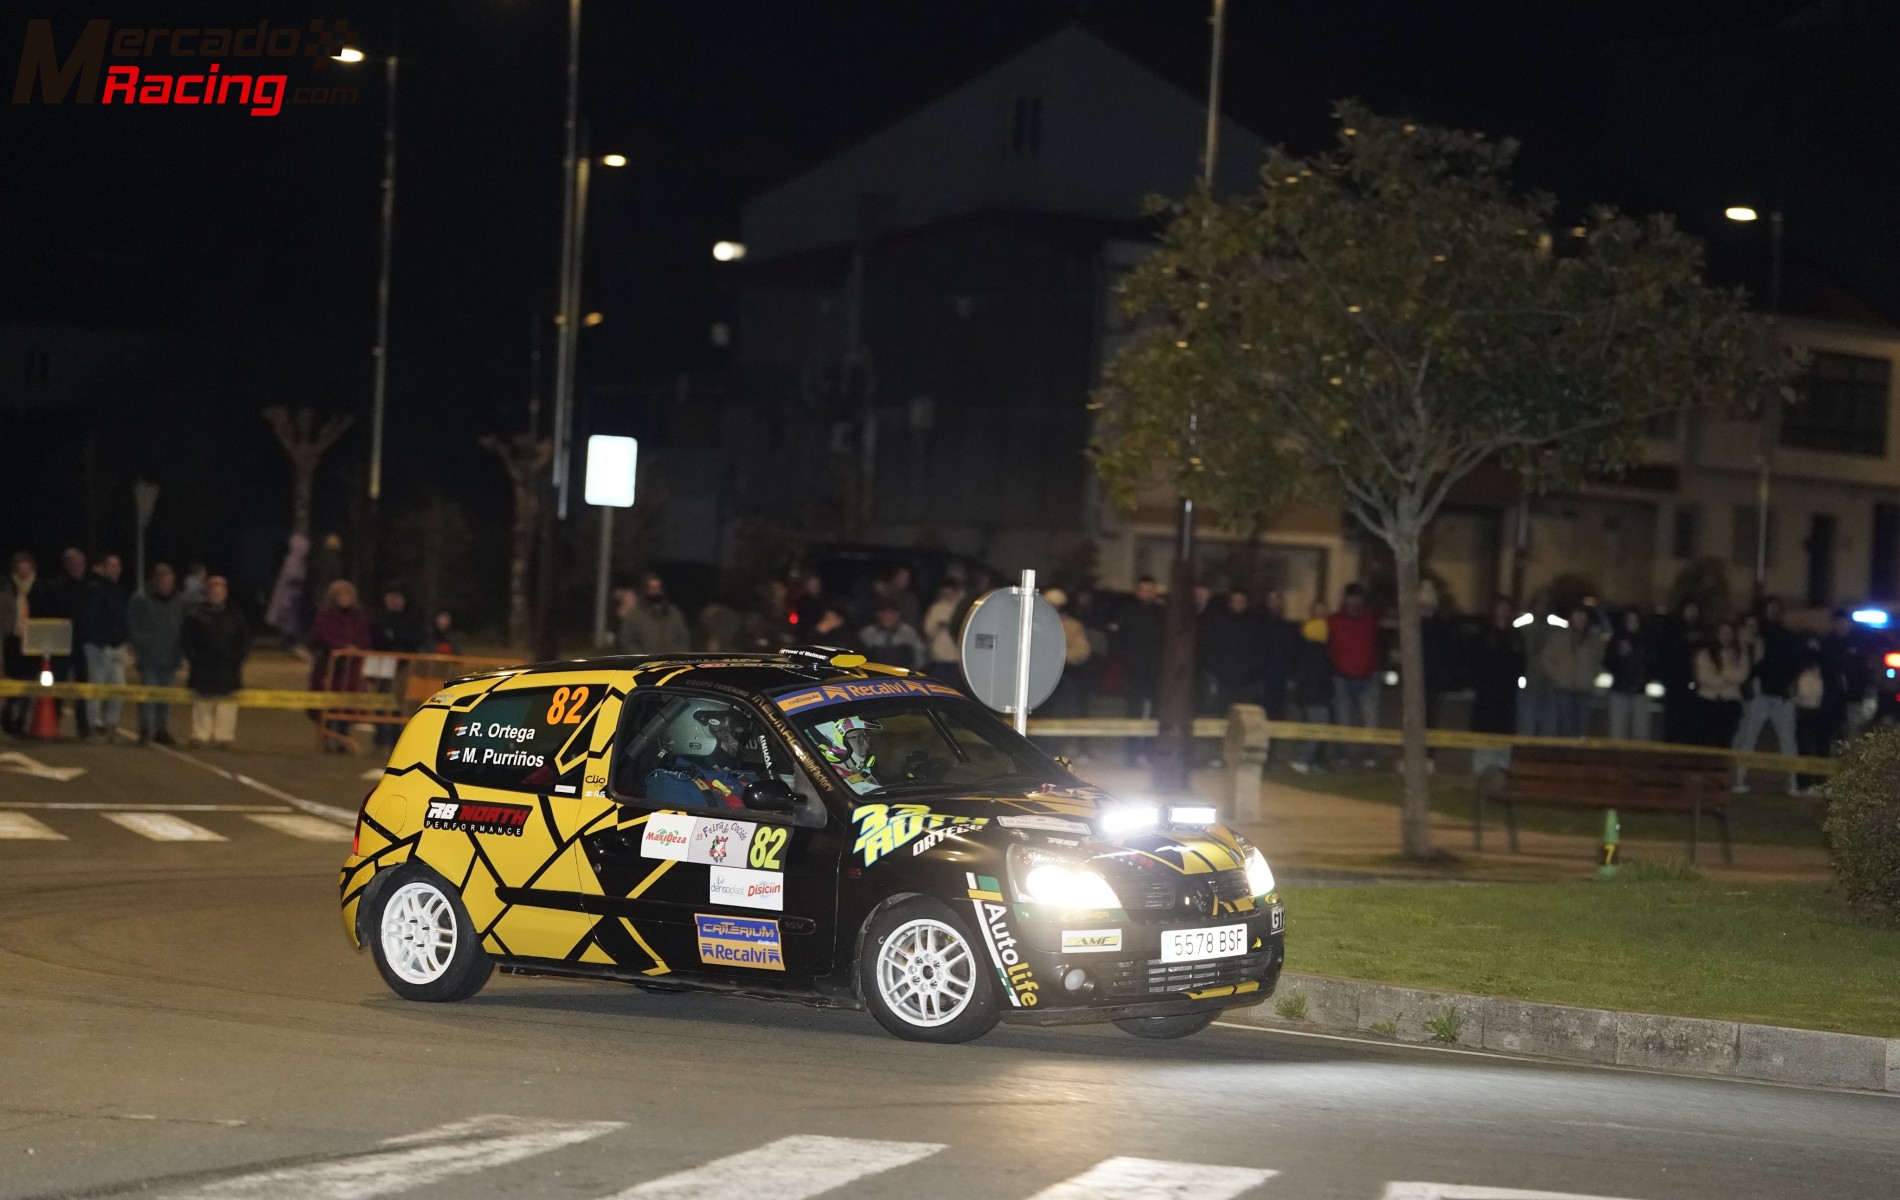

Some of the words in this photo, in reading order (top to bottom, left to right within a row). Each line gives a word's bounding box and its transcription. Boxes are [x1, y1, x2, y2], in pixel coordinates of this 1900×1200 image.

[847, 682, 907, 698] Recalvi
[546, 686, 590, 725] 82
[469, 722, 483, 737] R.
[488, 723, 535, 743] Ortega
[462, 748, 478, 764] M.
[482, 748, 544, 768] Purriños
[585, 775, 606, 784] Clio
[427, 802, 459, 820] RB
[459, 805, 529, 826] NORTH
[425, 820, 521, 836] PERFORMANCE
[645, 831, 687, 844] MaxiDeza
[702, 821, 724, 838] Feira
[730, 822, 748, 841] Cocido
[750, 826, 787, 869] 82
[1173, 934, 1214, 956] 5578
[1219, 929, 1243, 952] BSF
[715, 944, 767, 963] Recalvi
[983, 902, 1039, 1007] Autolife
